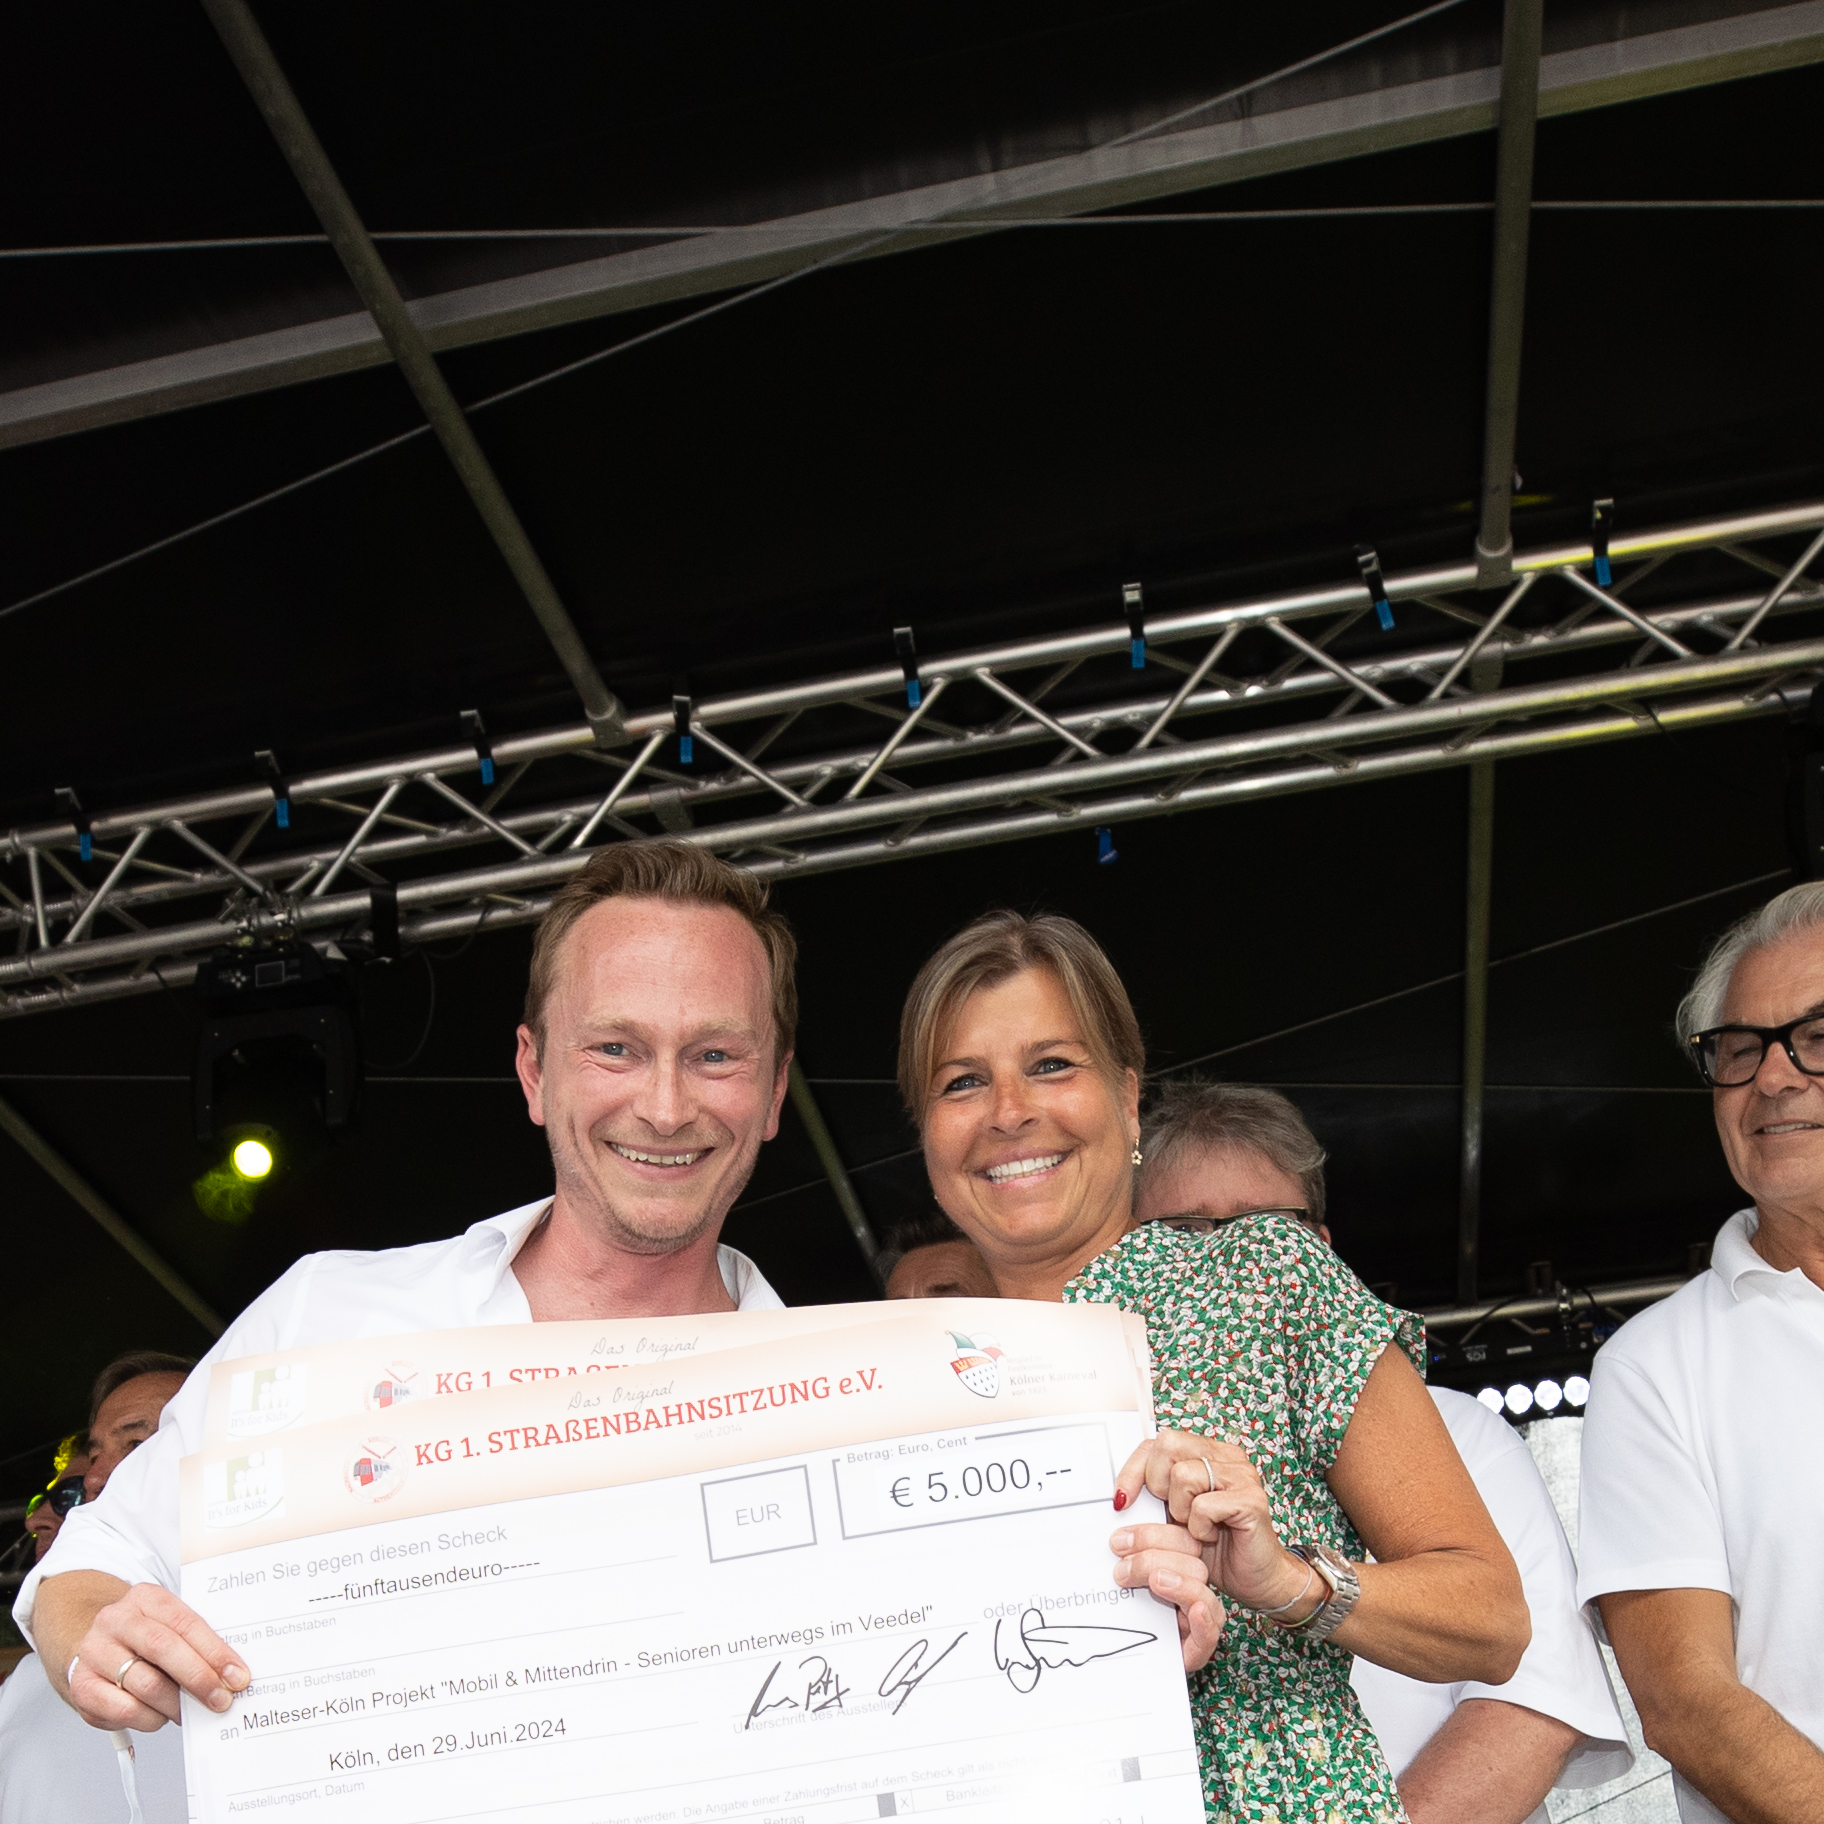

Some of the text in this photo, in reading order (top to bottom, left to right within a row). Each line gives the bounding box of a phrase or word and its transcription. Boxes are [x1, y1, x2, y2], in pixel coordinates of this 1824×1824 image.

[436, 1373, 474, 1394] KG
[1010, 1370, 1097, 1386] Kölner Karneval
[568, 1380, 673, 1410] Das Original
[265, 1411, 288, 1423] Kids
[415, 1439, 453, 1466] KG
[462, 1437, 481, 1459] 1.
[838, 1368, 883, 1396] e.V.
[846, 1434, 968, 1465] Betrag: Euro, Cent
[225, 1505, 242, 1516] for
[244, 1498, 267, 1511] Kids
[888, 1476, 915, 1509] €
[734, 1502, 782, 1528] EUR
[206, 1526, 508, 1593] Zahlen Sie gegen diesen Scheck
[983, 1600, 1024, 1620] oder
[266, 1616, 337, 1638] Buchstaben
[220, 1725, 240, 1741] an
[243, 1696, 366, 1731] Malteser-Köln
[371, 1684, 436, 1714] Projekt
[505, 1671, 519, 1688] &
[525, 1658, 618, 1684] Mittendrin
[637, 1641, 721, 1669] Senioren
[727, 1624, 825, 1658] unterwegs
[830, 1619, 853, 1638] im
[246, 1681, 286, 1697] Betrag
[304, 1666, 376, 1688] Buchstaben
[810, 1707, 833, 1722] des
[329, 1717, 567, 1772] Köln, den 29.Juni.2024
[228, 1780, 365, 1813] Ausstellungsort, Datum
[683, 1806, 703, 1819] Die
[706, 1798, 749, 1817] Angabe
[751, 1793, 781, 1807] einer
[783, 1779, 858, 1804] Zahlungsfrist
[861, 1777, 880, 1791] auf
[882, 1772, 908, 1786] dem
[911, 1765, 954, 1786] Scheck
